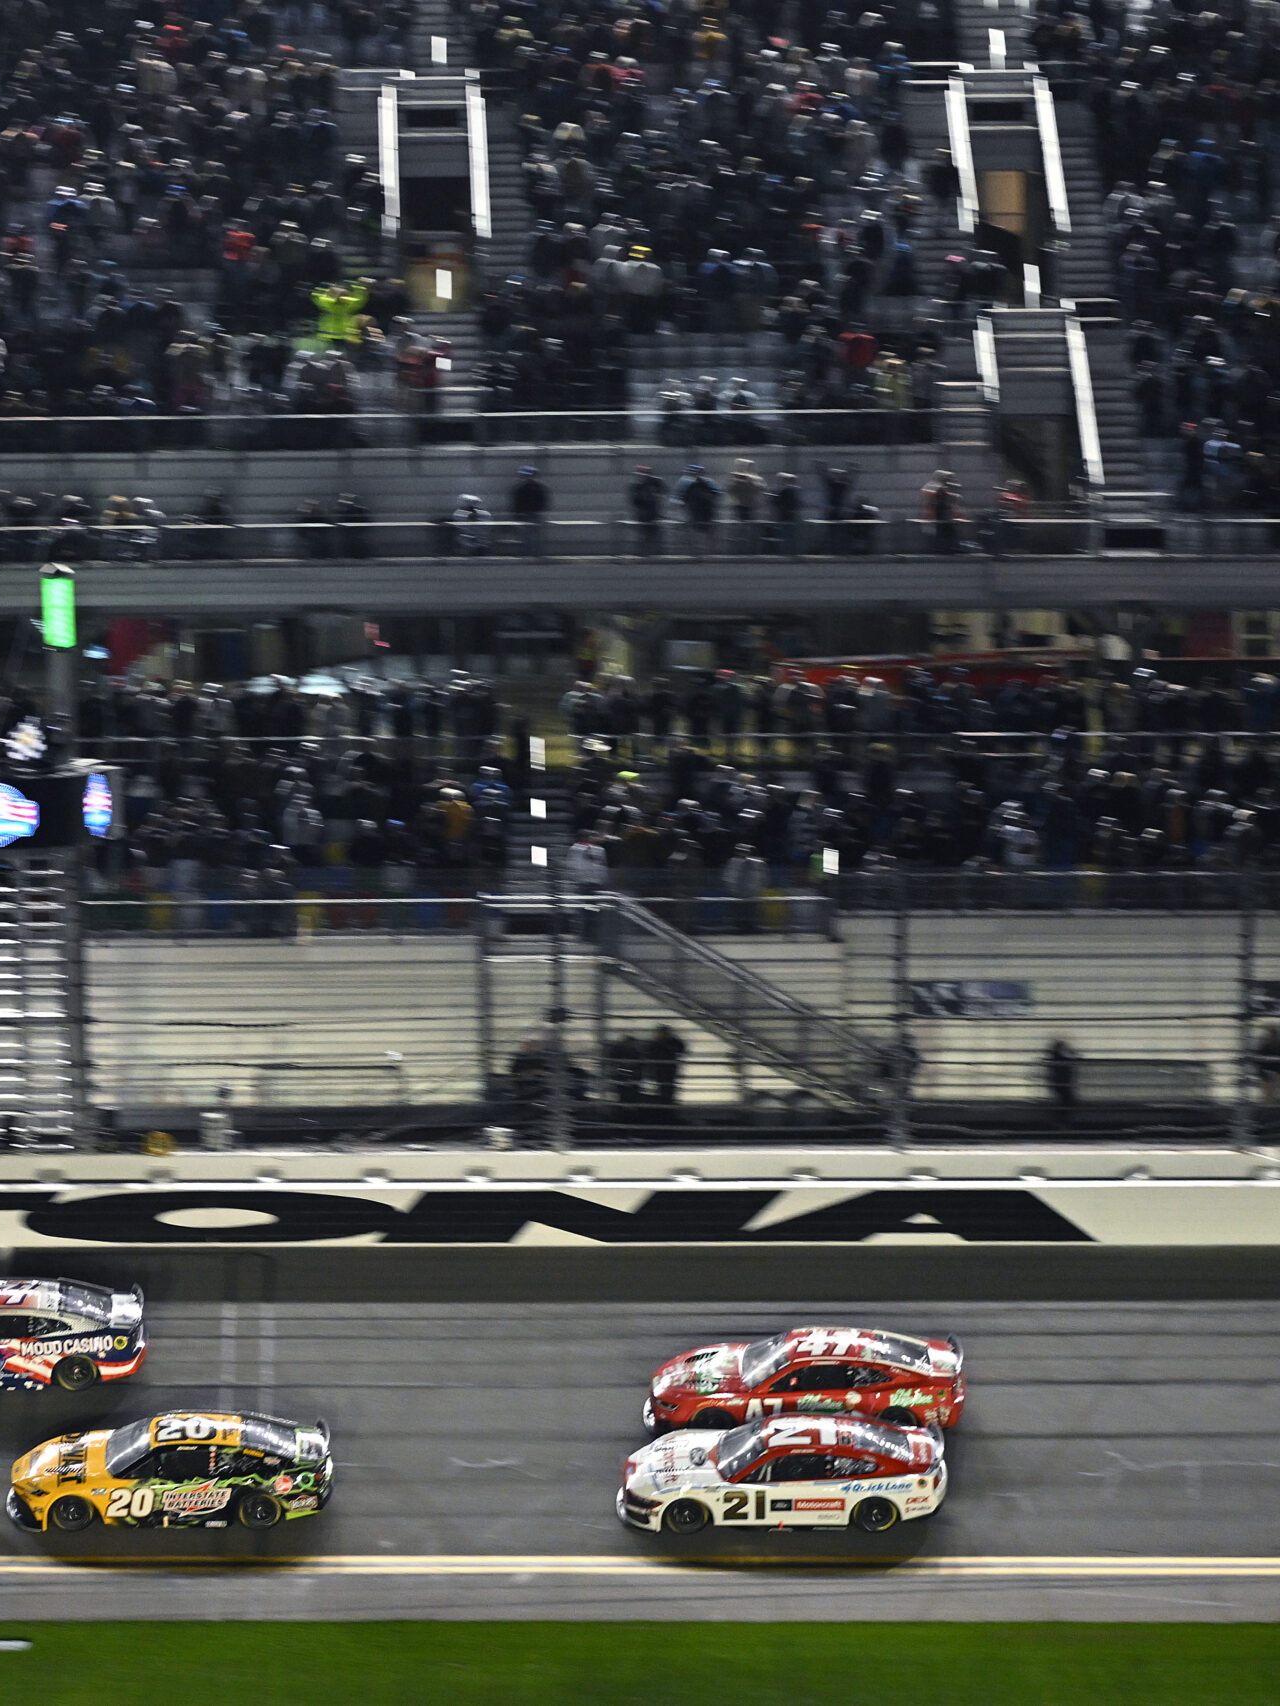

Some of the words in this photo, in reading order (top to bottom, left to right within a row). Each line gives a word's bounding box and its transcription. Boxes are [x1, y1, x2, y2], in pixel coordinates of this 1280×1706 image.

[21, 1340, 63, 1356] MODO
[63, 1335, 113, 1355] CASINO
[745, 1398, 783, 1422] 47
[157, 1416, 213, 1441] 20
[768, 1417, 837, 1447] 21
[106, 1488, 155, 1517] 20
[166, 1491, 228, 1500] INTERSTATE
[168, 1499, 224, 1508] BATTERIES
[723, 1490, 766, 1520] 21
